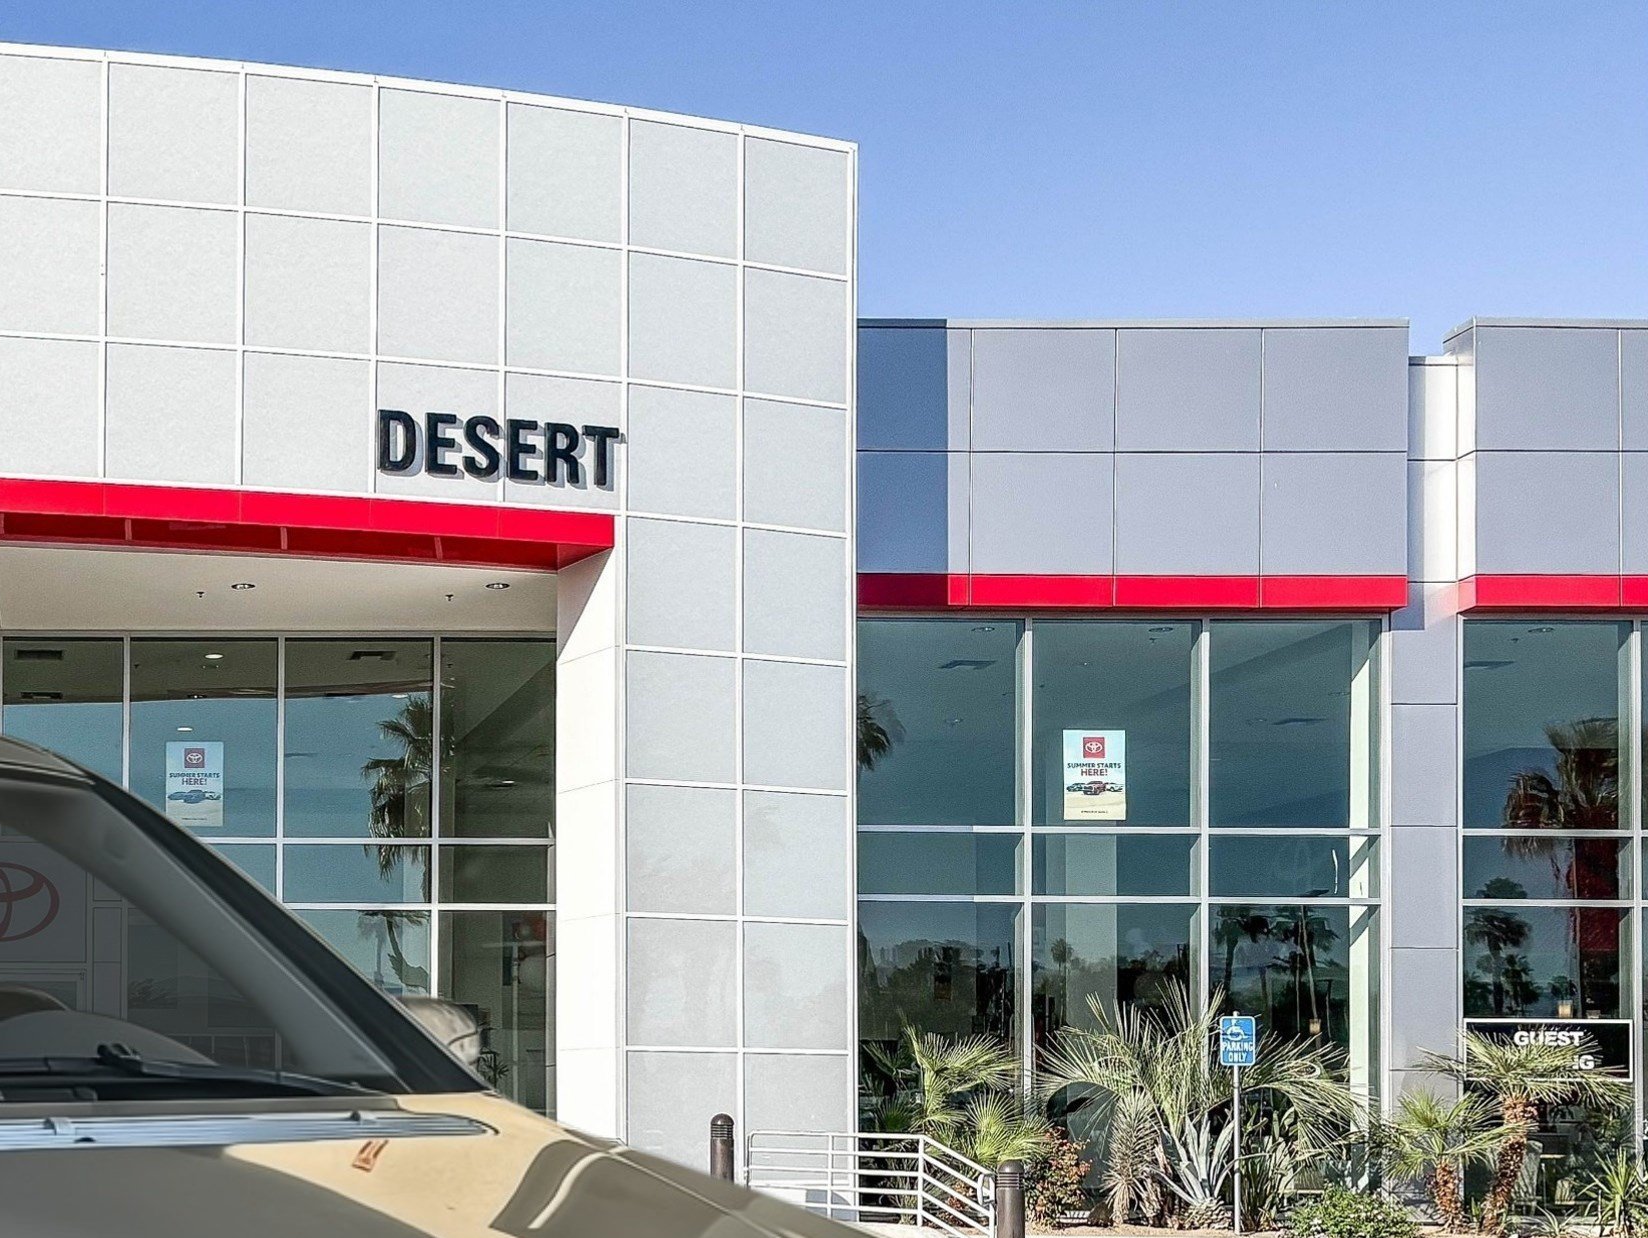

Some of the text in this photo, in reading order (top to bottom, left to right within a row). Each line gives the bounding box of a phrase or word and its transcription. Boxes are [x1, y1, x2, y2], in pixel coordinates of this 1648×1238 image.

[377, 408, 620, 486] DESERT
[1081, 768, 1108, 776] HERE!
[1513, 1030, 1584, 1047] GUEST
[1222, 1041, 1253, 1051] PARKING
[1228, 1052, 1247, 1062] ONLY
